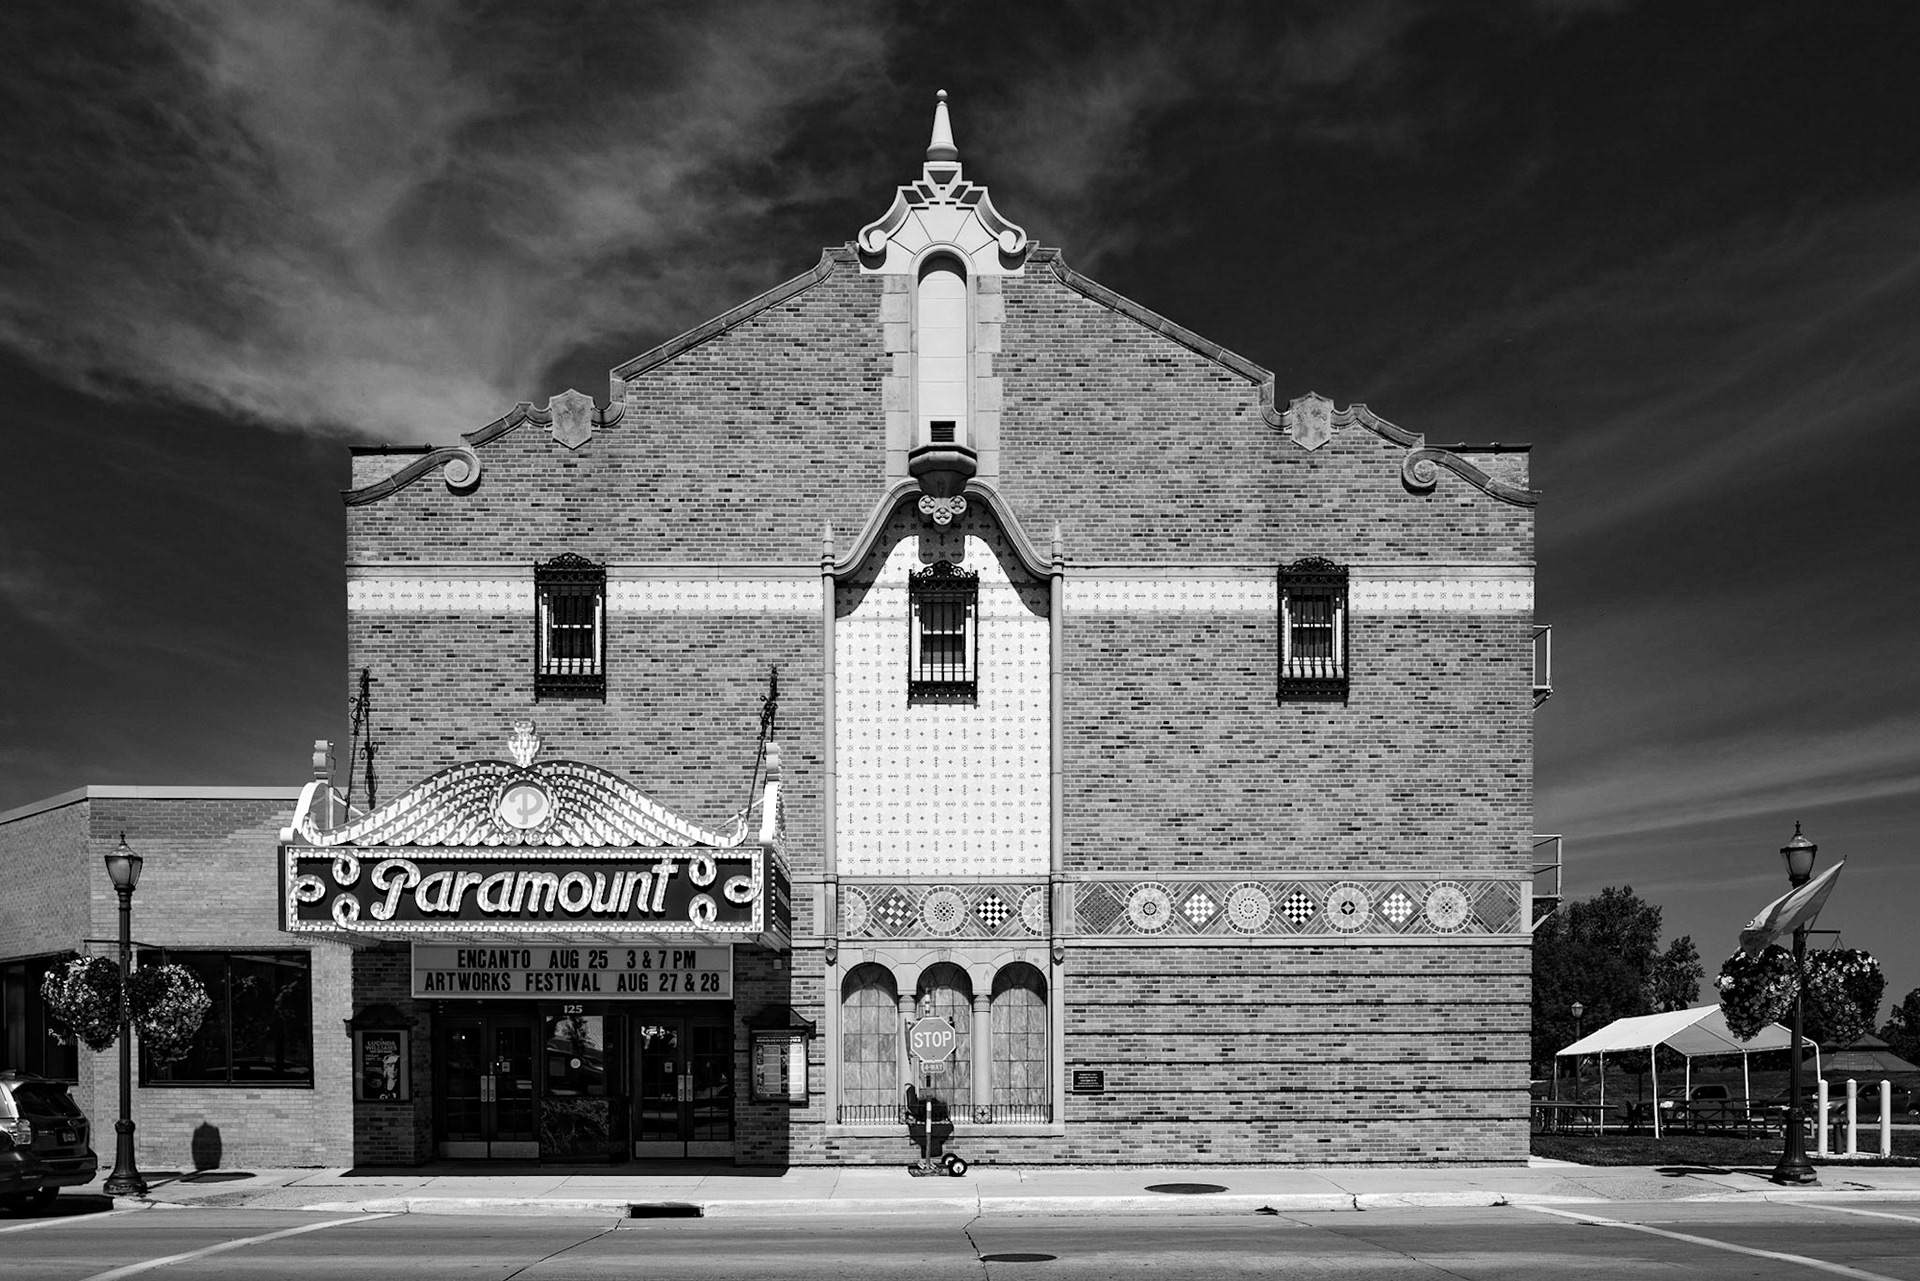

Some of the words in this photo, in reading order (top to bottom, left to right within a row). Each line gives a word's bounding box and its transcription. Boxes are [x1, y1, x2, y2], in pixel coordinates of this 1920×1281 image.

[508, 787, 544, 825] P
[370, 858, 678, 921] Paramount
[457, 949, 531, 969] ENCANTO
[549, 949, 580, 969] AUG
[588, 949, 609, 969] 25
[626, 949, 636, 969] 3
[642, 949, 652, 969] &
[658, 949, 668, 969] 7
[673, 949, 696, 969] PM
[424, 972, 511, 992] ARTWORKS
[525, 972, 601, 992] FESTIVAL
[617, 972, 649, 992] AUG
[658, 972, 677, 992] 27
[684, 972, 695, 992] &
[700, 972, 720, 992] 28
[563, 1004, 583, 1014] 125
[914, 1031, 952, 1048] STOP
